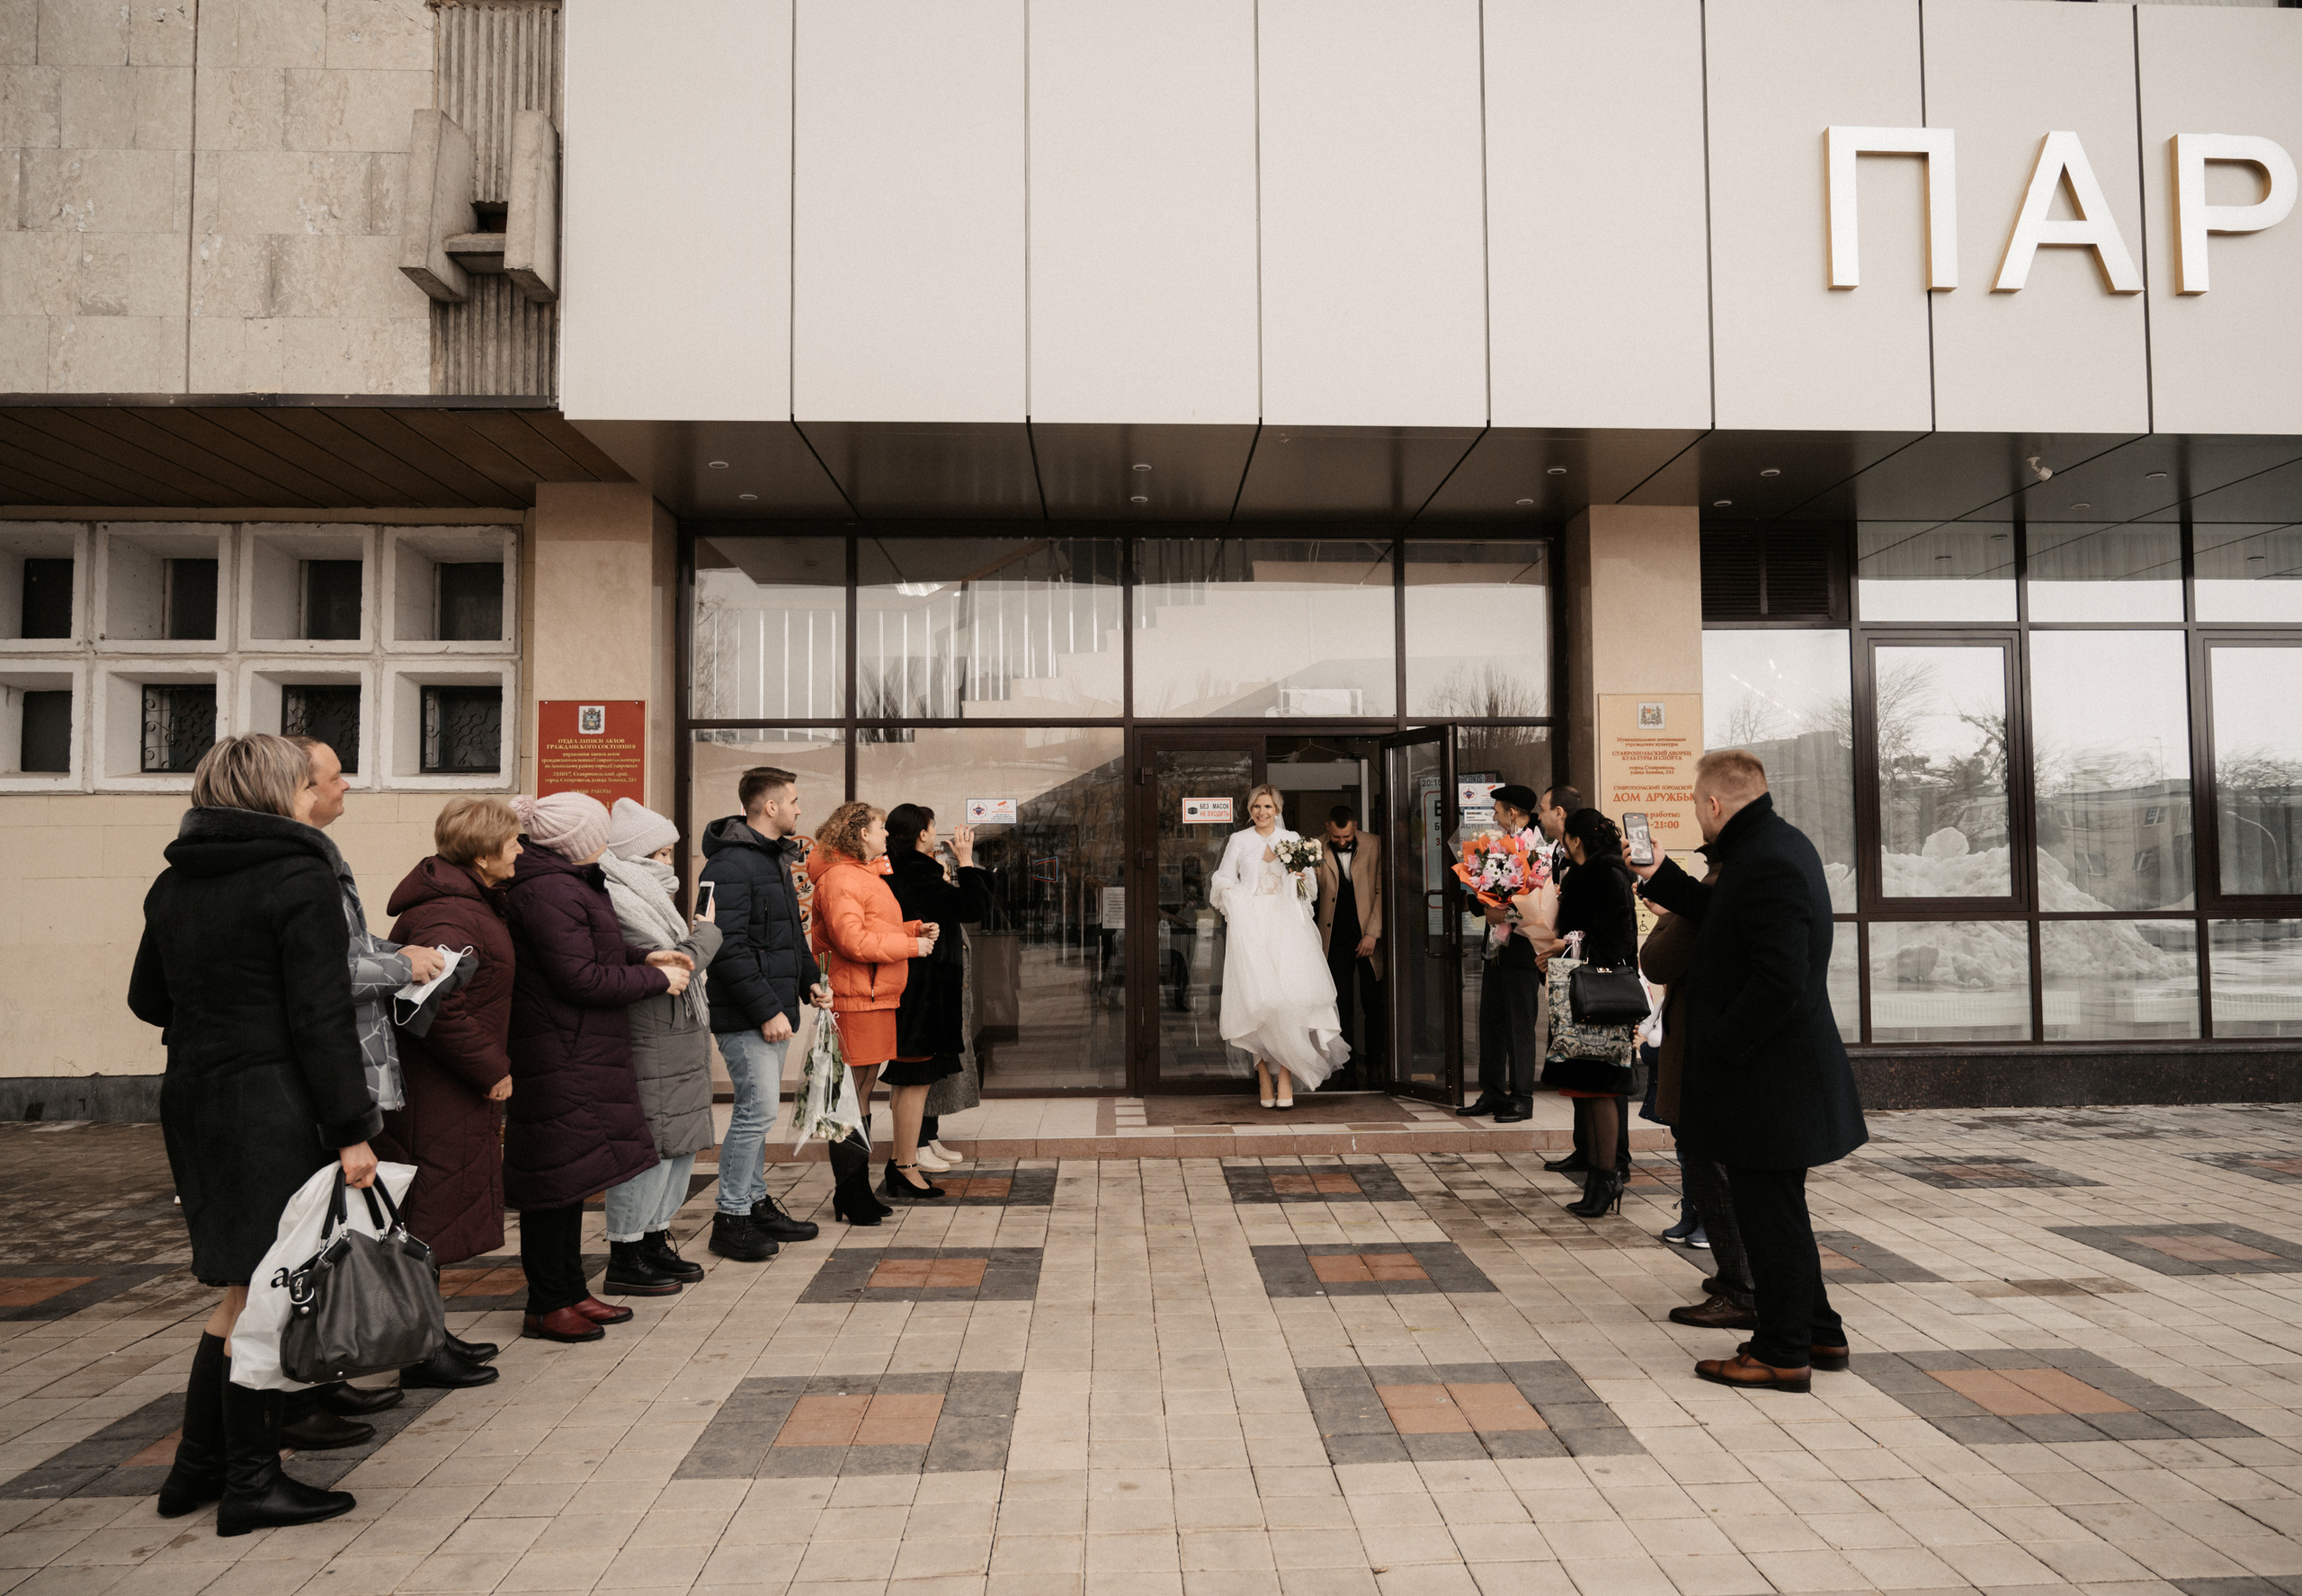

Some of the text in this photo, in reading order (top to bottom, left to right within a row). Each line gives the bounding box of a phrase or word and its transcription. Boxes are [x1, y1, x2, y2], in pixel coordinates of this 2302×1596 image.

[1823, 125, 2298, 296] ПАР
[1613, 793, 1693, 801] ДОМ ДРУЖБЫ
[1647, 821, 1680, 829] -21:00
